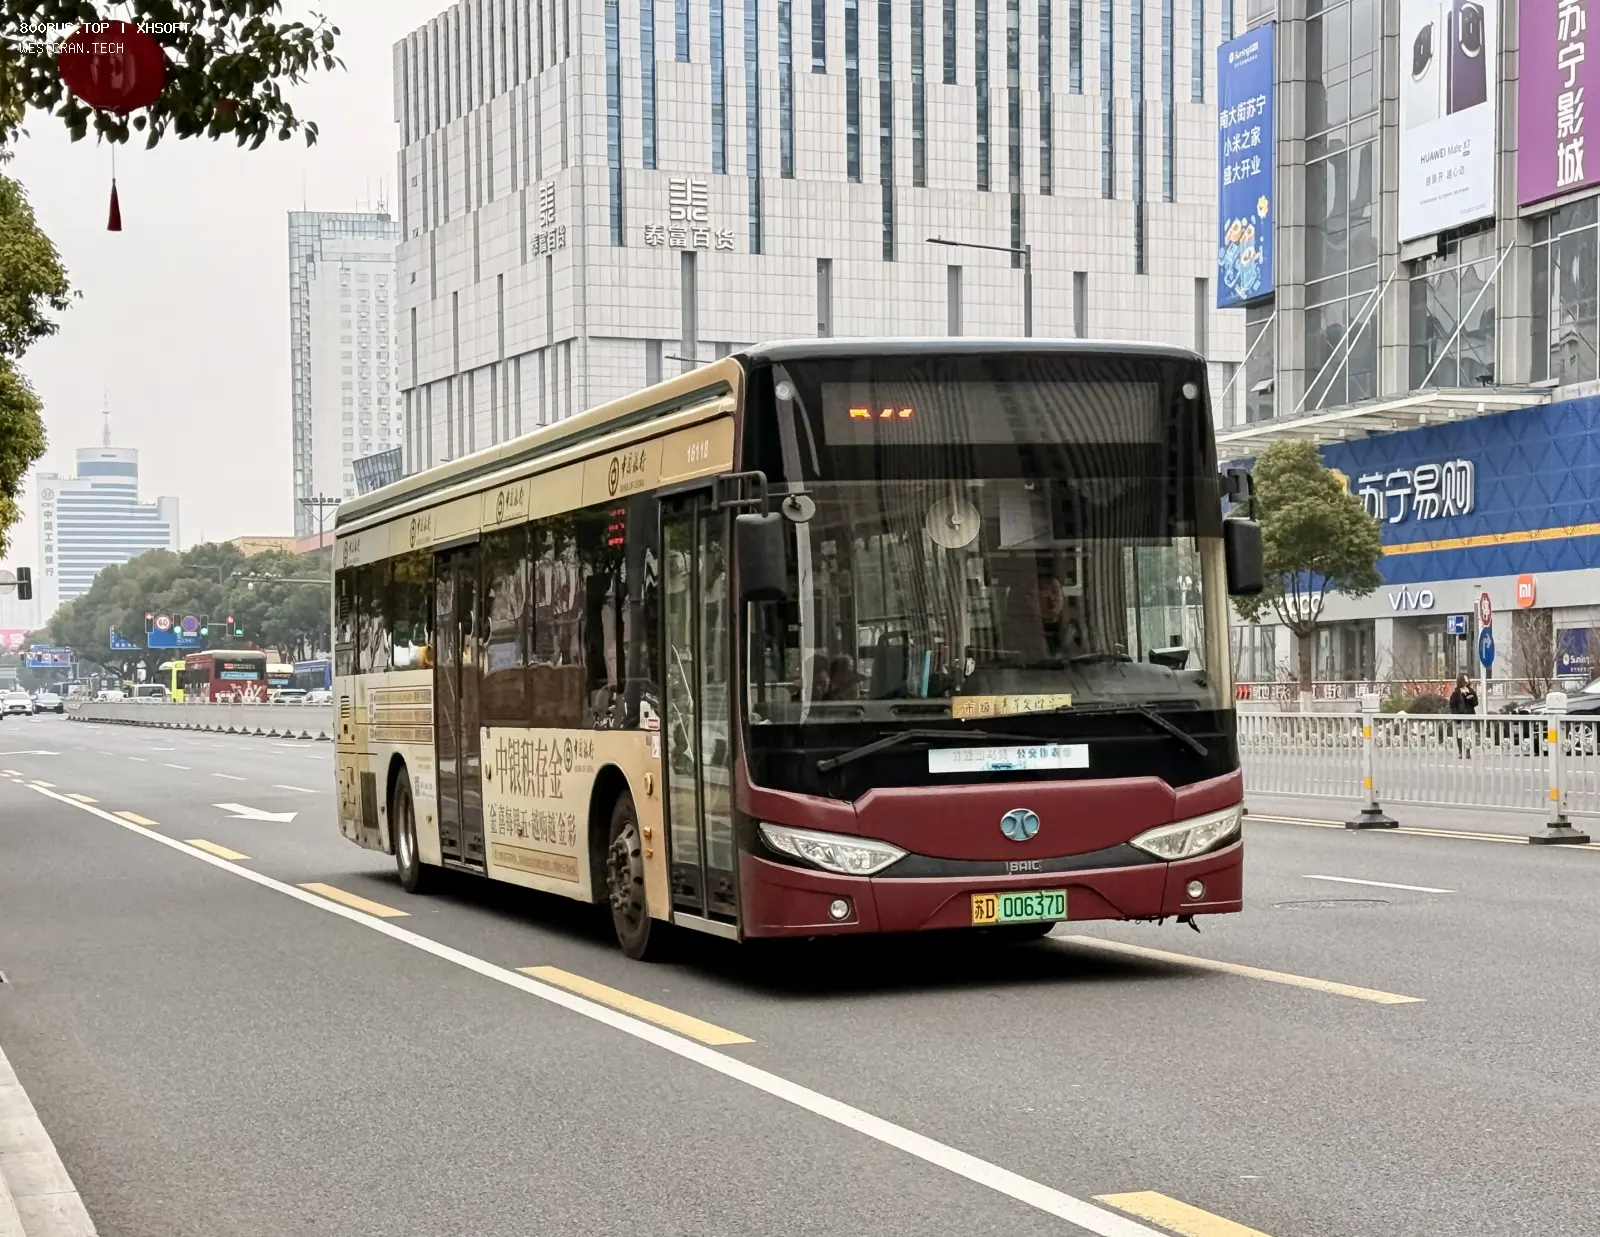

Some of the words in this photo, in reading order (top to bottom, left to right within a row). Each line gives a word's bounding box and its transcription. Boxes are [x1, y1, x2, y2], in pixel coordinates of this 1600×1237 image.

[1557, 0, 1586, 187] 苏宁影城
[1220, 94, 1266, 130] 南大街苏宁
[1224, 125, 1261, 157] 小米之家
[1420, 147, 1447, 164] HUAWEI
[1224, 155, 1261, 186] 盛大开业
[645, 224, 735, 251] 泰富百货
[687, 440, 709, 464] 16118
[1358, 459, 1475, 524] 苏宁易购
[44, 510, 54, 576] 中国工商银行
[1388, 585, 1435, 611] vivo
[158, 619, 168, 627] 60
[495, 736, 563, 799] 中银积存金
[1010, 861, 1040, 871] BAIC
[975, 898, 996, 919] 苏D
[1003, 894, 1065, 918] 00637D
